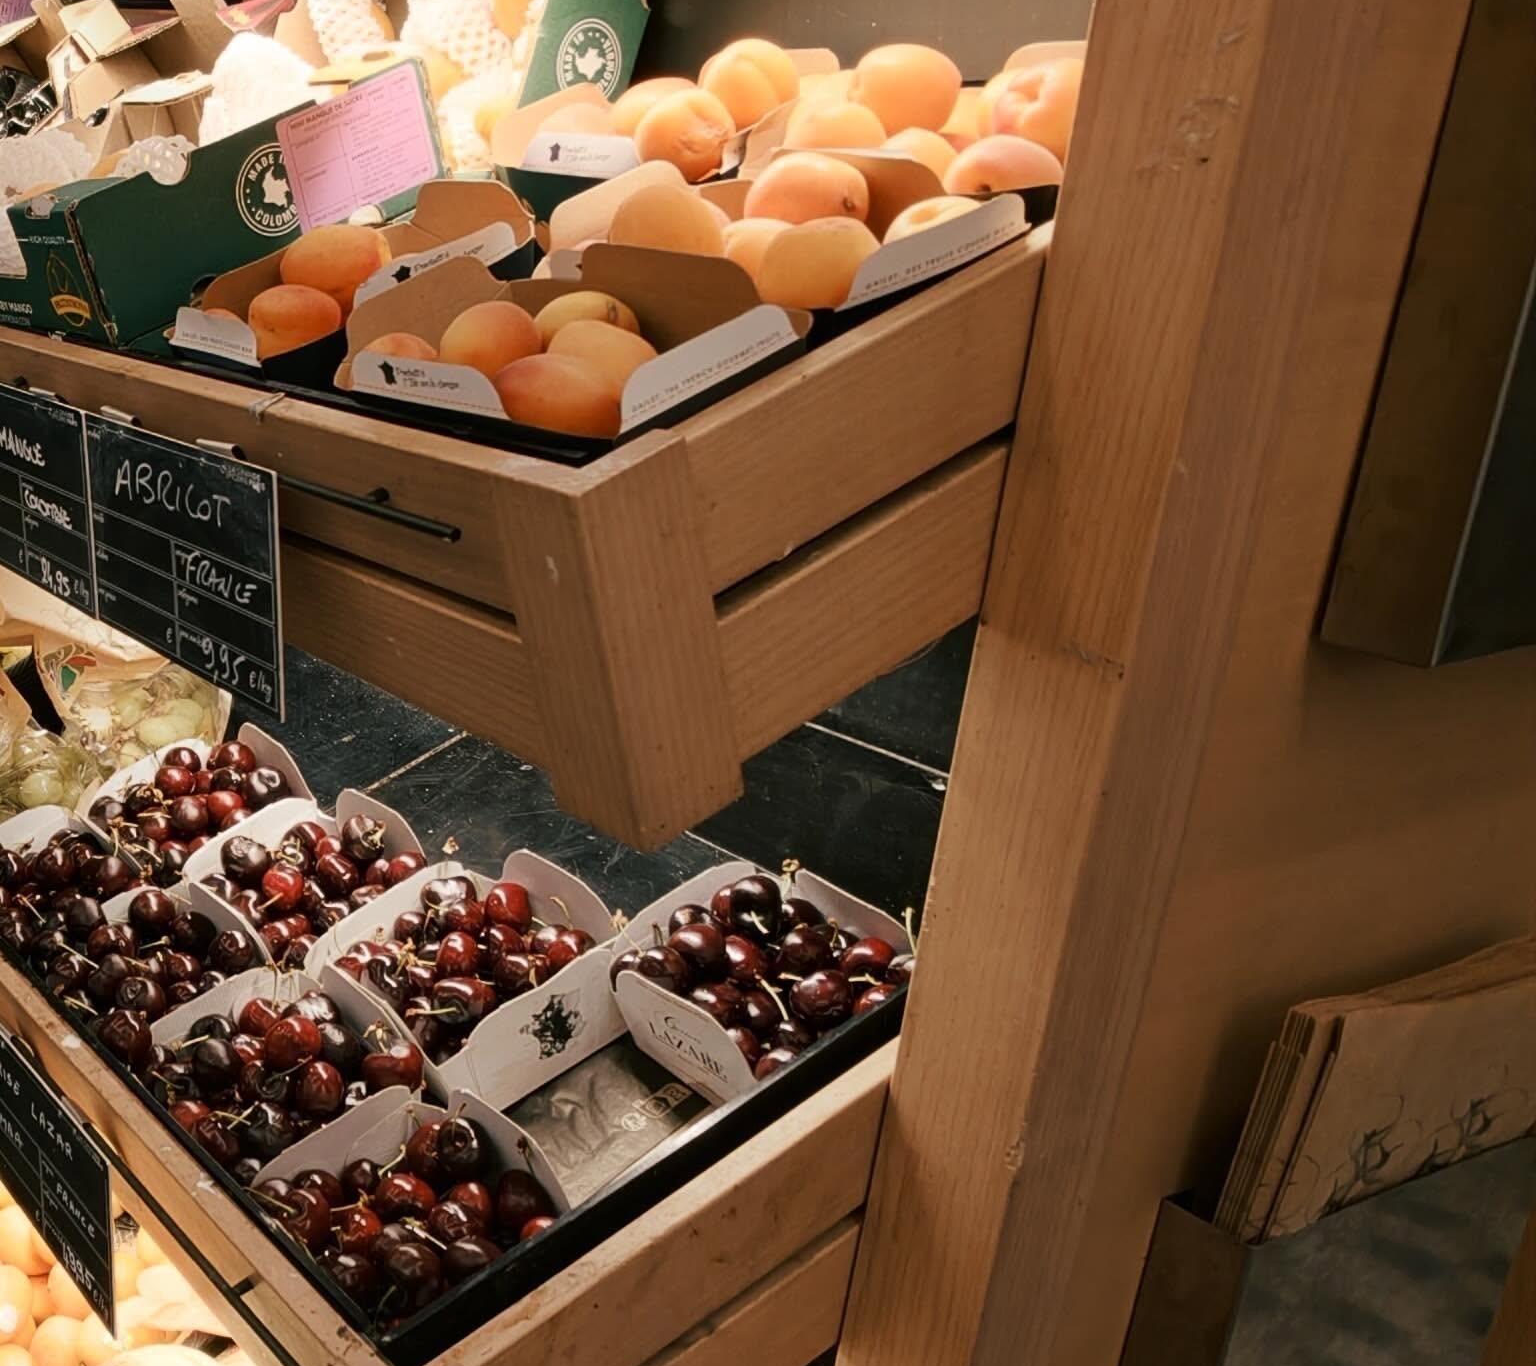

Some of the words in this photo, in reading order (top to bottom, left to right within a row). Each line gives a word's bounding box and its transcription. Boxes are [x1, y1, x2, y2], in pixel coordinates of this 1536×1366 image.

[247, 153, 275, 182] MADE
[255, 203, 298, 227] COLOMB
[186, 550, 257, 603] FRANCE
[30, 1101, 73, 1161] LAZAR
